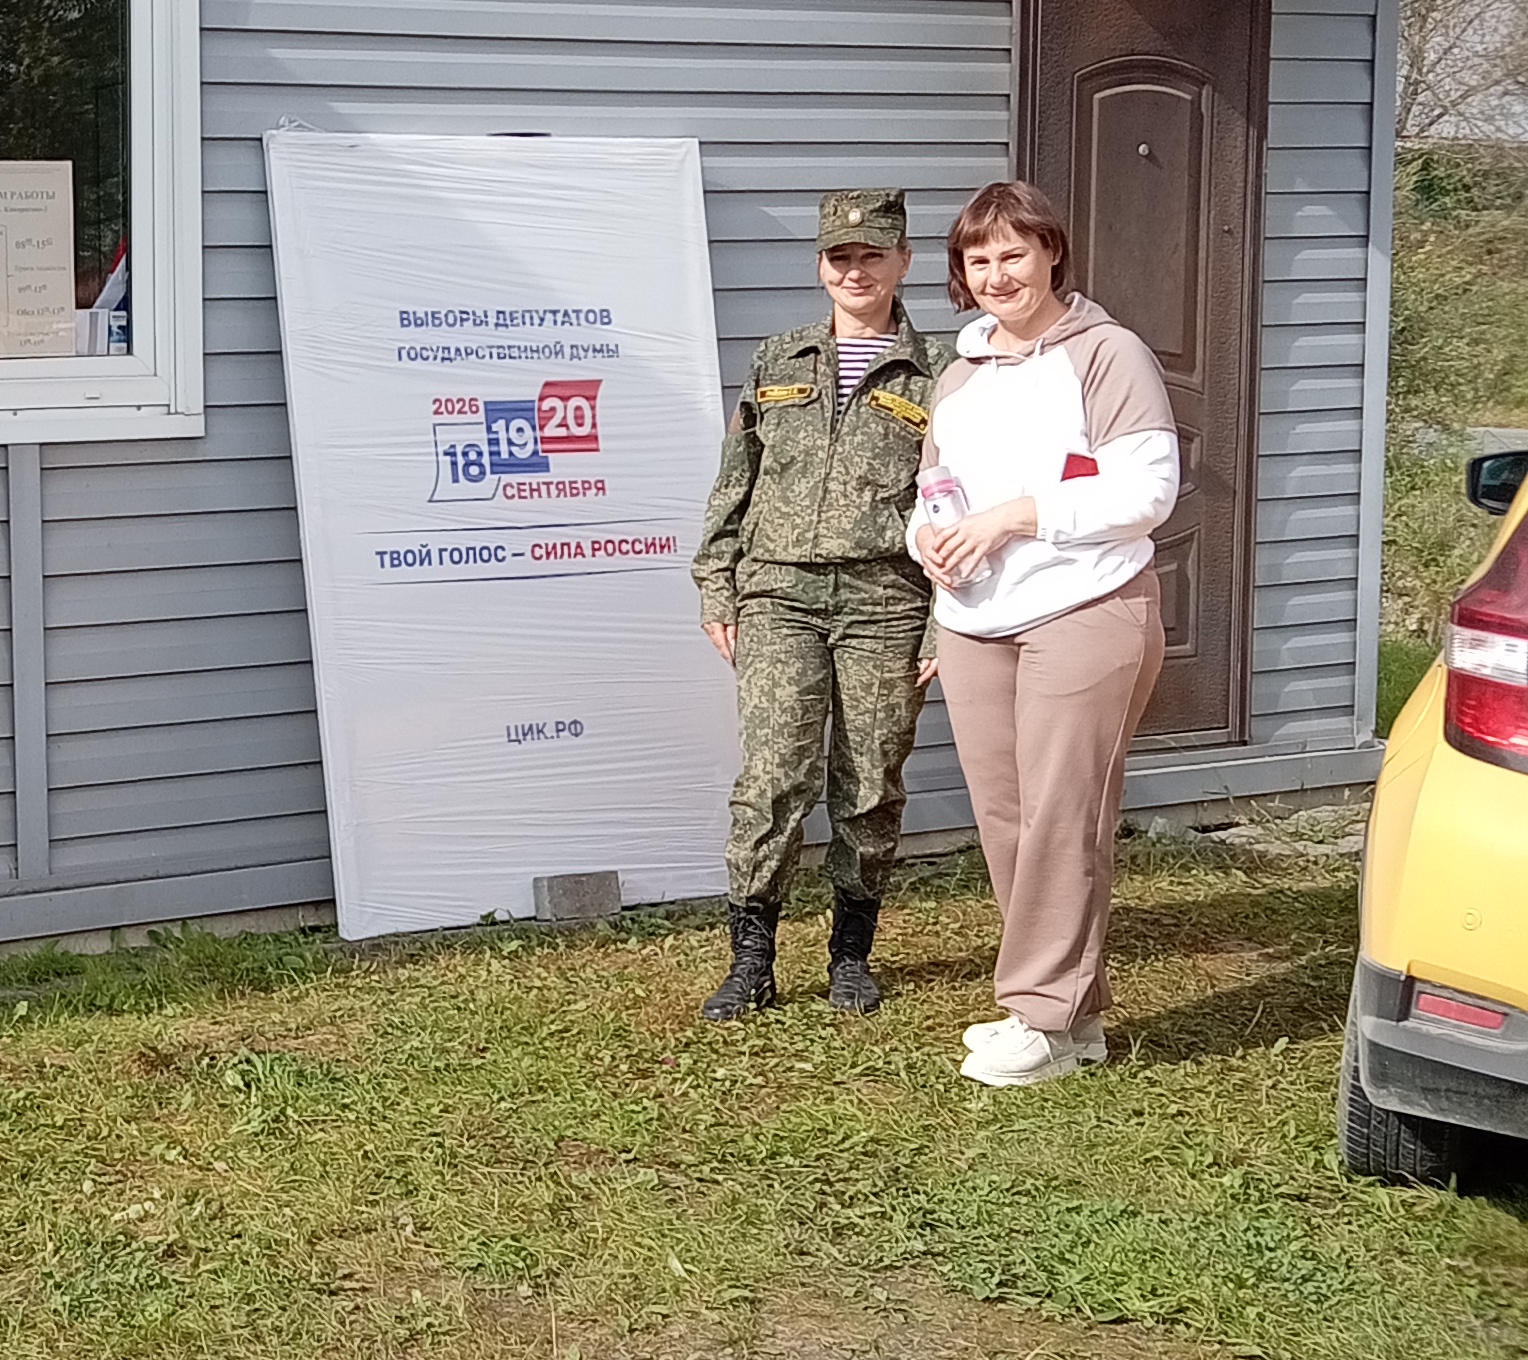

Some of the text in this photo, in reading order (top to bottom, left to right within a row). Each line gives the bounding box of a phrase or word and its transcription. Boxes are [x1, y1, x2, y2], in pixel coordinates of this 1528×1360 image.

[10, 190, 56, 201] РАБОТЫ
[398, 308, 613, 330] ВЫБОРЫ ДЕПУТАТОВ
[397, 341, 621, 363] ГОСУДАРСТВЕННОЙ ДУМЫ
[431, 397, 480, 416] 2026
[442, 396, 593, 484] 18 19 20
[502, 479, 607, 501] СЕНТЯБРЯ
[375, 544, 433, 569] ТВОЙ
[438, 545, 507, 567] ГОЛОС
[530, 541, 586, 562] СИЛА
[590, 536, 678, 559] РОССИИ!
[506, 718, 584, 745] ЦИК.РФ
